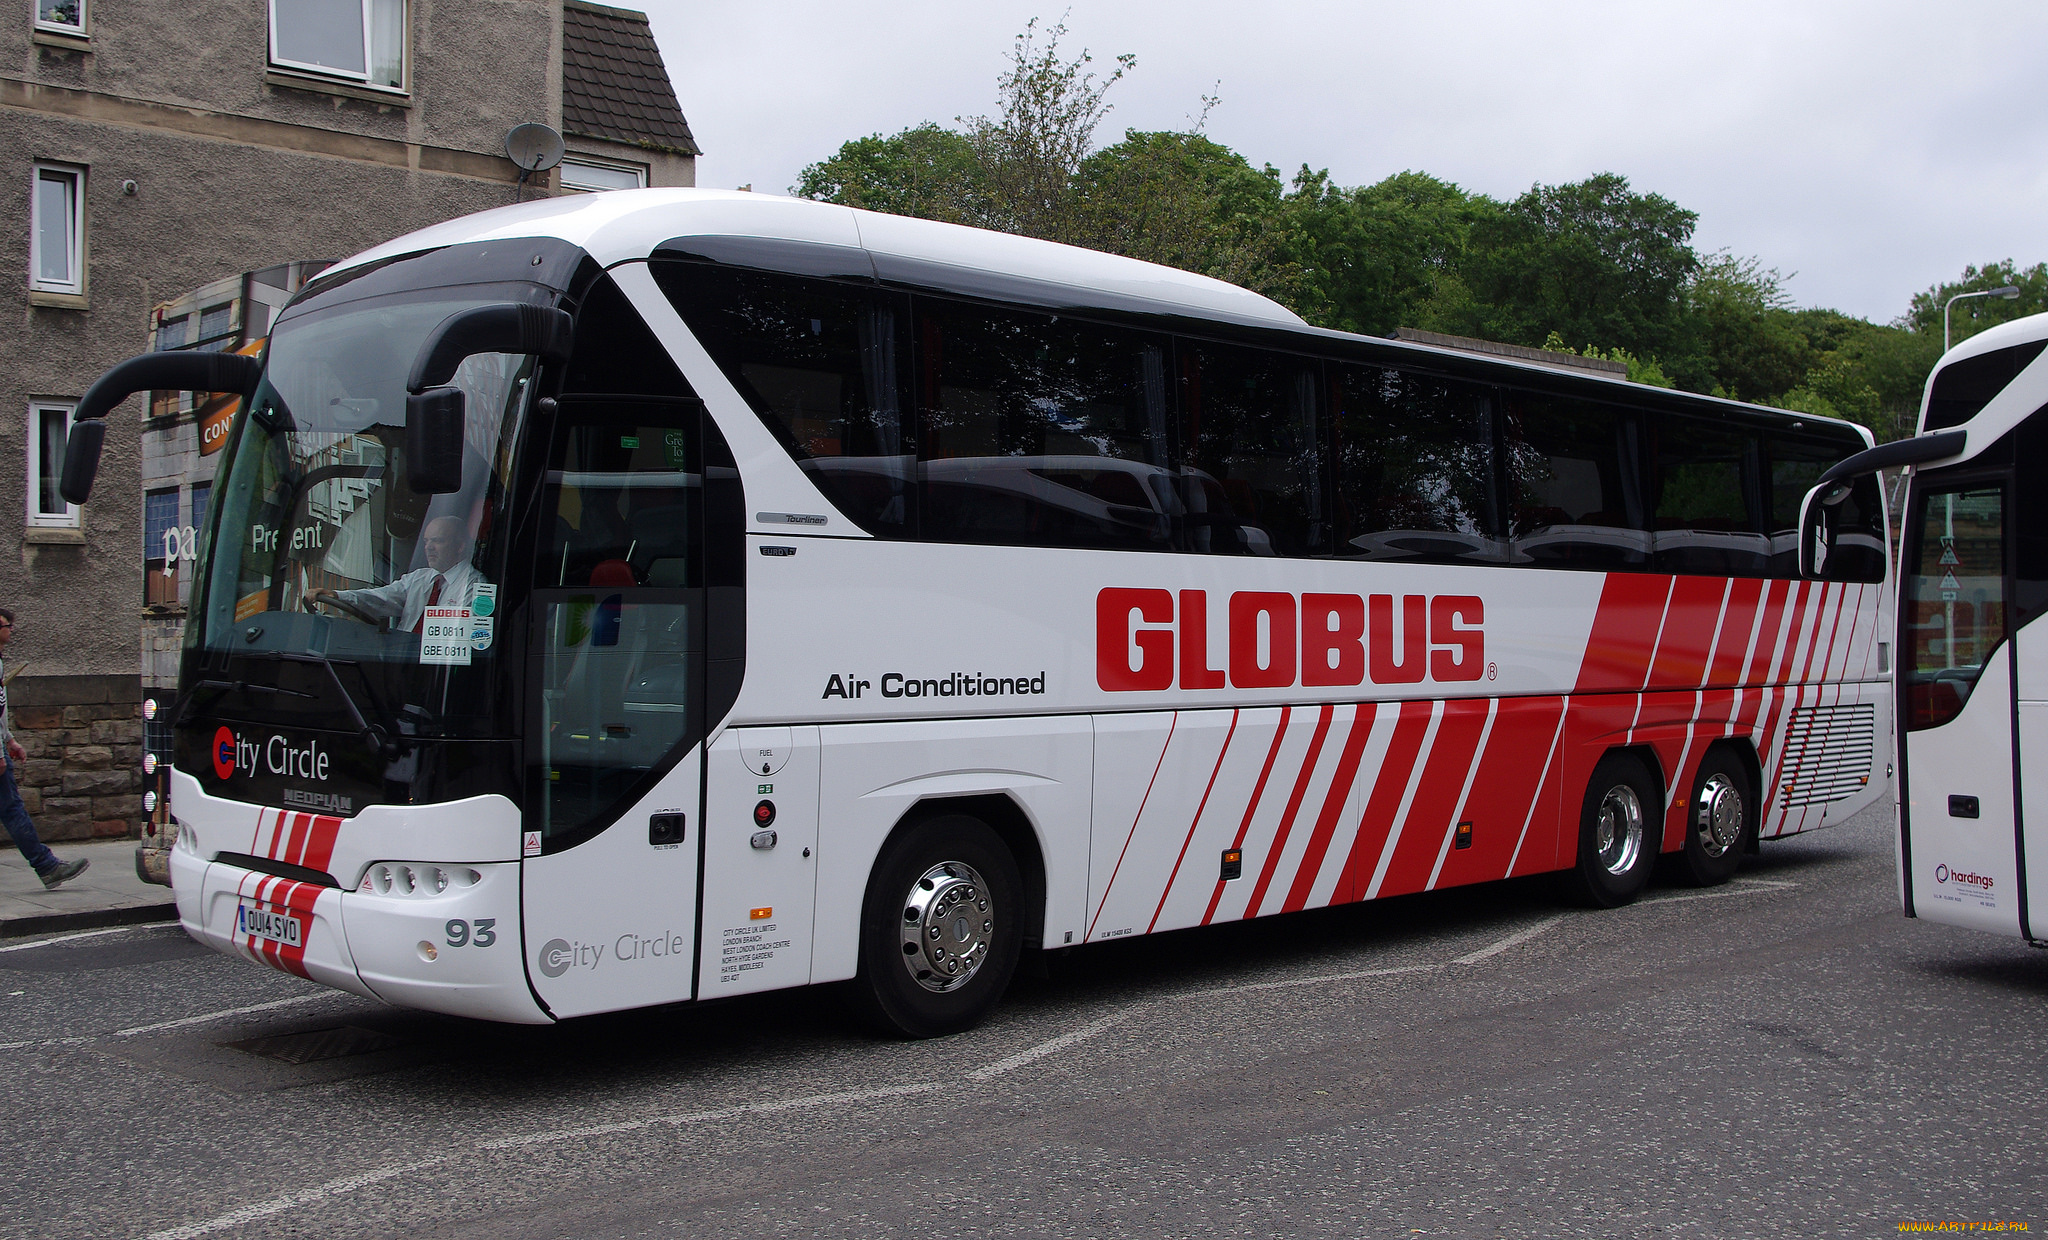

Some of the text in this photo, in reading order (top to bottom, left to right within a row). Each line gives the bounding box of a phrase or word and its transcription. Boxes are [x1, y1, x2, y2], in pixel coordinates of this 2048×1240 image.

[785, 514, 825, 524] Tourliner
[252, 521, 323, 553] Preent
[762, 548, 784, 556] EURO
[427, 609, 470, 618] GLOBUS
[428, 625, 440, 637] GB
[442, 626, 464, 637] 0811
[1096, 587, 1485, 692] GLOBUS
[423, 645, 467, 657] GBE 0811
[822, 671, 1046, 700] Air Conditioned
[212, 726, 329, 781] City Circle
[759, 749, 773, 757] FUEL
[283, 788, 352, 814] NEOPLAN
[1950, 869, 1994, 890] hardings
[445, 918, 497, 948] 93
[723, 928, 734, 937] CITY
[735, 927, 751, 935] CIRCLE
[759, 924, 776, 932] LIMITED
[722, 935, 762, 946] LONDON BRANCH
[538, 929, 684, 978] City Circle
[723, 940, 791, 955] WEST LONDON COACH CENTRE
[721, 951, 774, 964] NORTH HYDE GARDENS
[739, 961, 764, 971] MIDDLESEX
